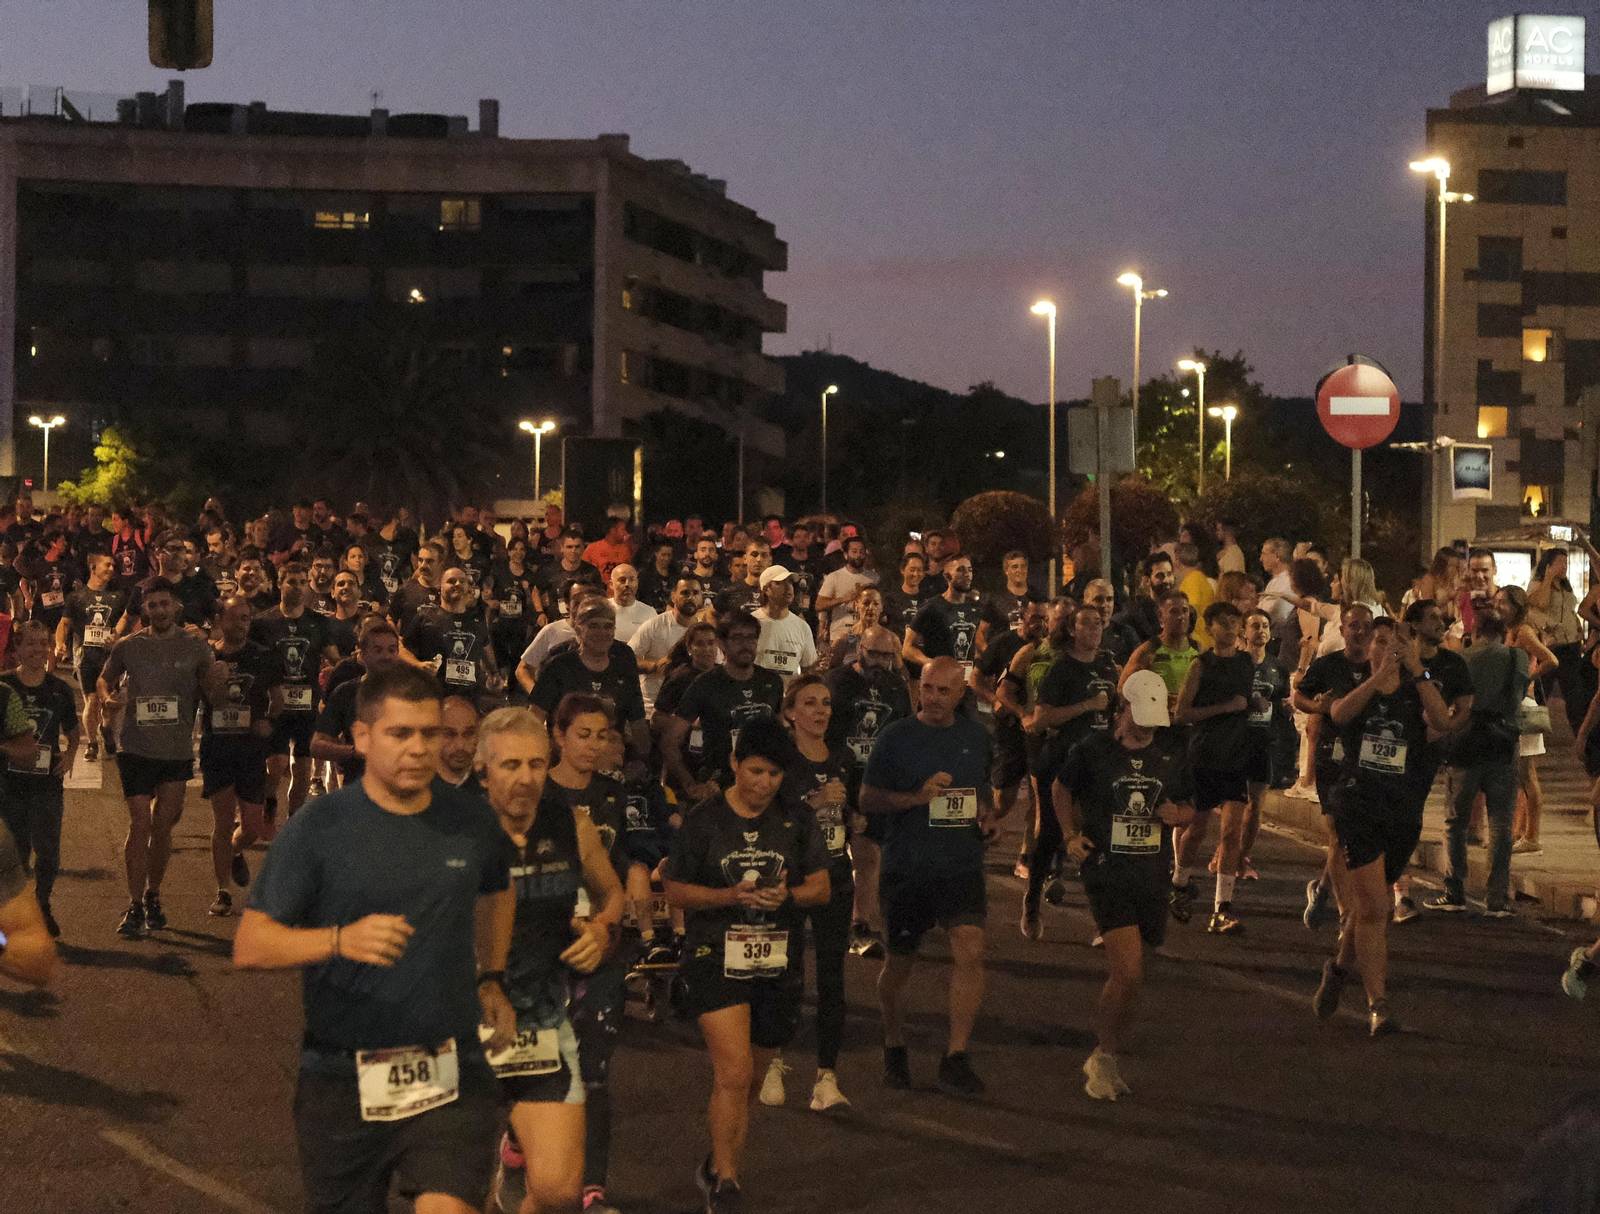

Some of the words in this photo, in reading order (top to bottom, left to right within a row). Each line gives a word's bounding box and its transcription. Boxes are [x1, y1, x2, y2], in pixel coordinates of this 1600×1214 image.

[1492, 26, 1512, 57] AC
[1525, 25, 1574, 54] AC
[1524, 54, 1574, 66] HOTELS
[90, 630, 104, 639] 1191
[773, 655, 788, 665] 198
[455, 665, 470, 675] 495
[287, 690, 303, 700] 456
[146, 702, 168, 713] 1075
[1372, 743, 1397, 758] 1238
[945, 797, 965, 811] 787
[1125, 824, 1151, 838] 1219
[743, 942, 772, 960] 339
[386, 1060, 431, 1087] 458
